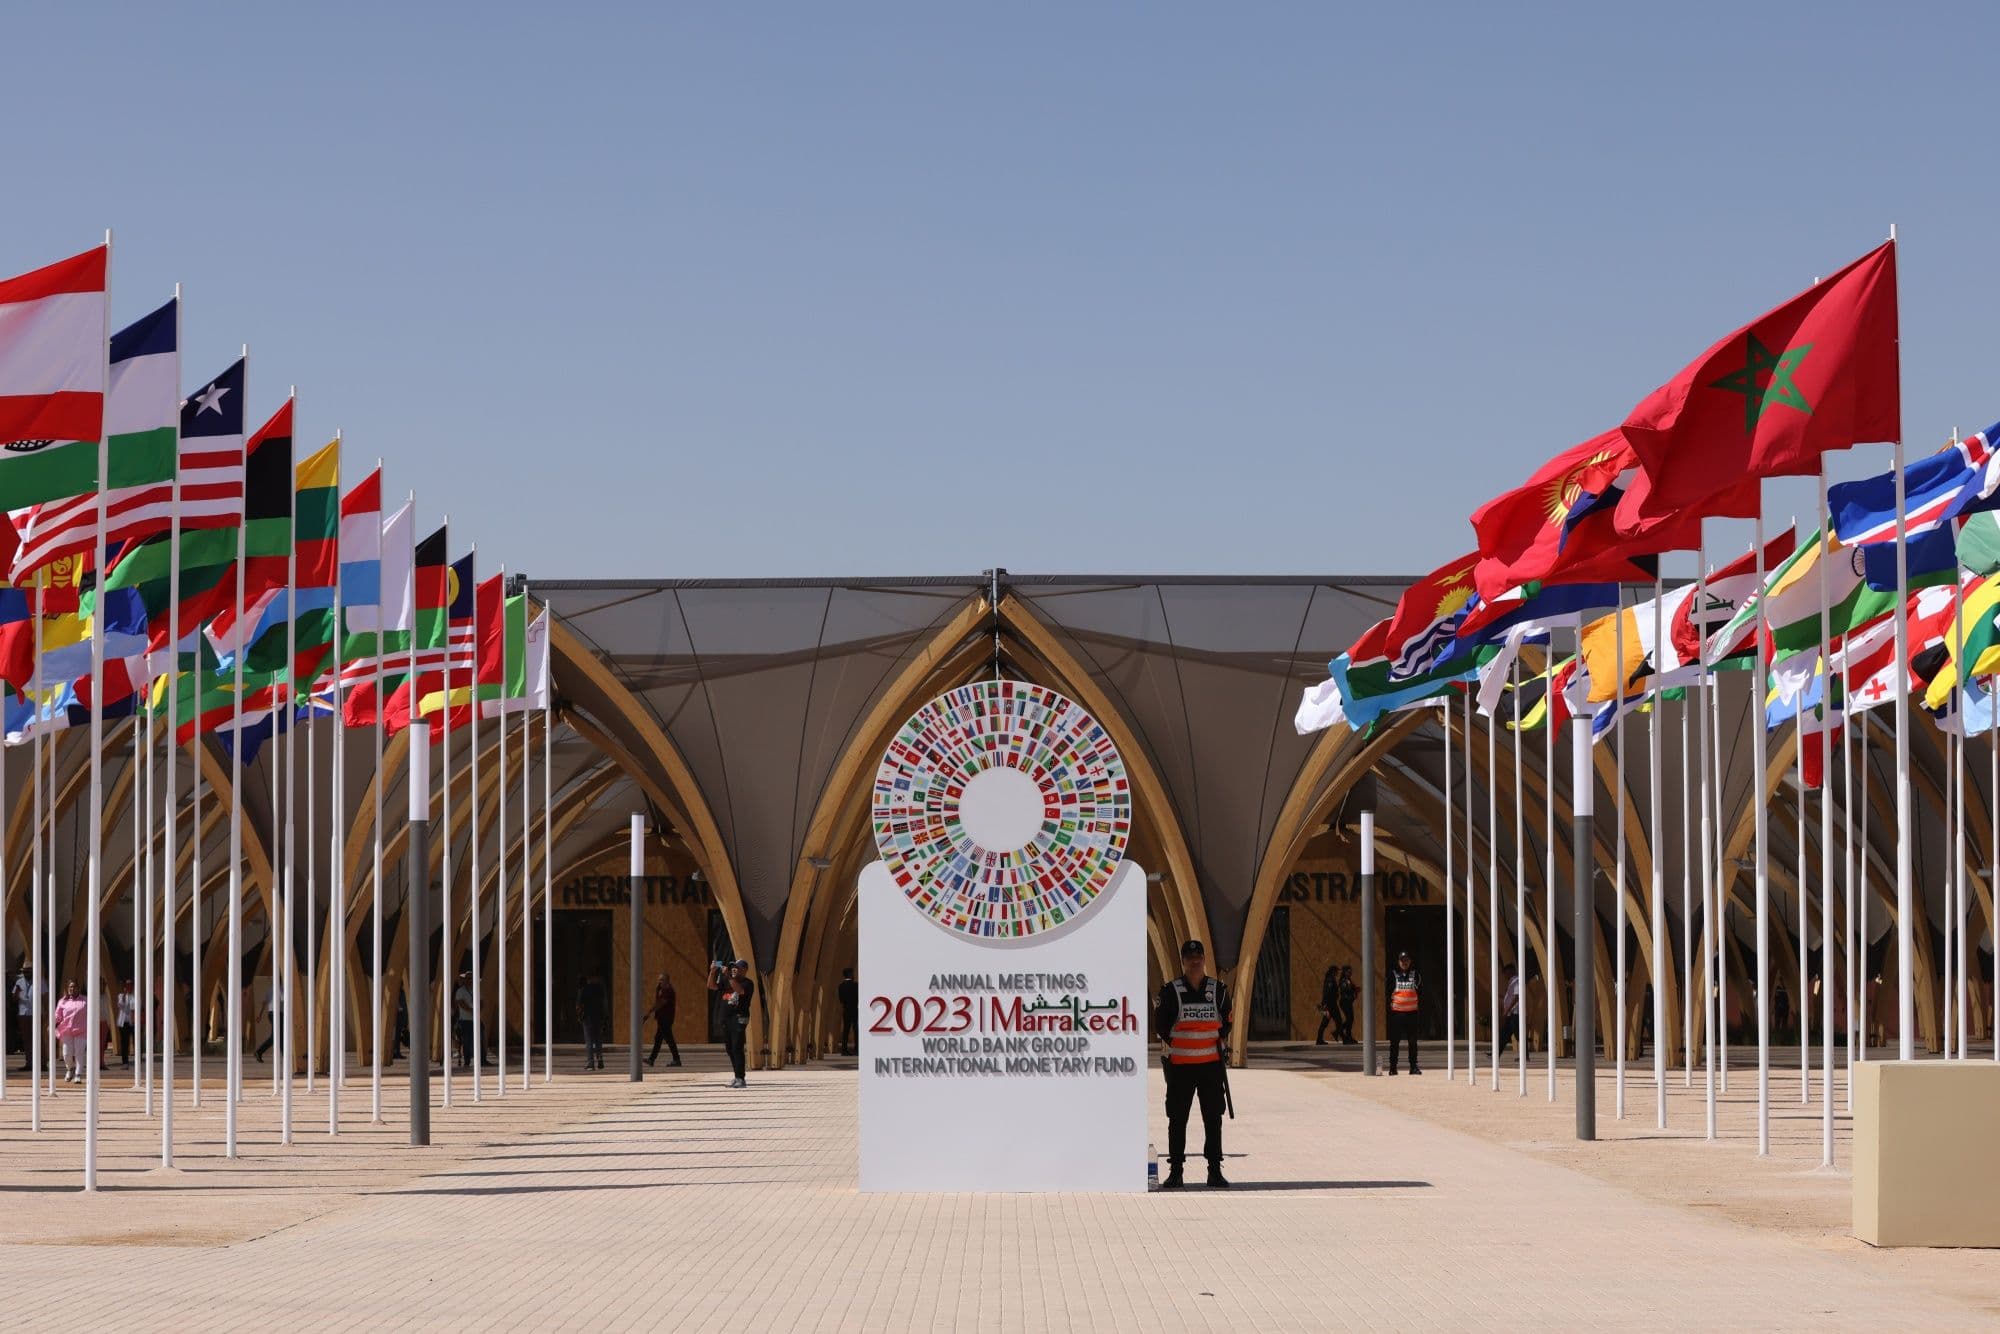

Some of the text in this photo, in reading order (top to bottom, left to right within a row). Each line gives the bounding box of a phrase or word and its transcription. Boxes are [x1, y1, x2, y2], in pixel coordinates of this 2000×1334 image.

[928, 973, 1087, 990] ANNUAL MEETINGS
[868, 995, 1138, 1033] 2023 Marrakech
[922, 1036, 1088, 1054] WORLD BANK GROUP
[874, 1056, 1135, 1074] INTERNATIONAL MONETARY FUND
